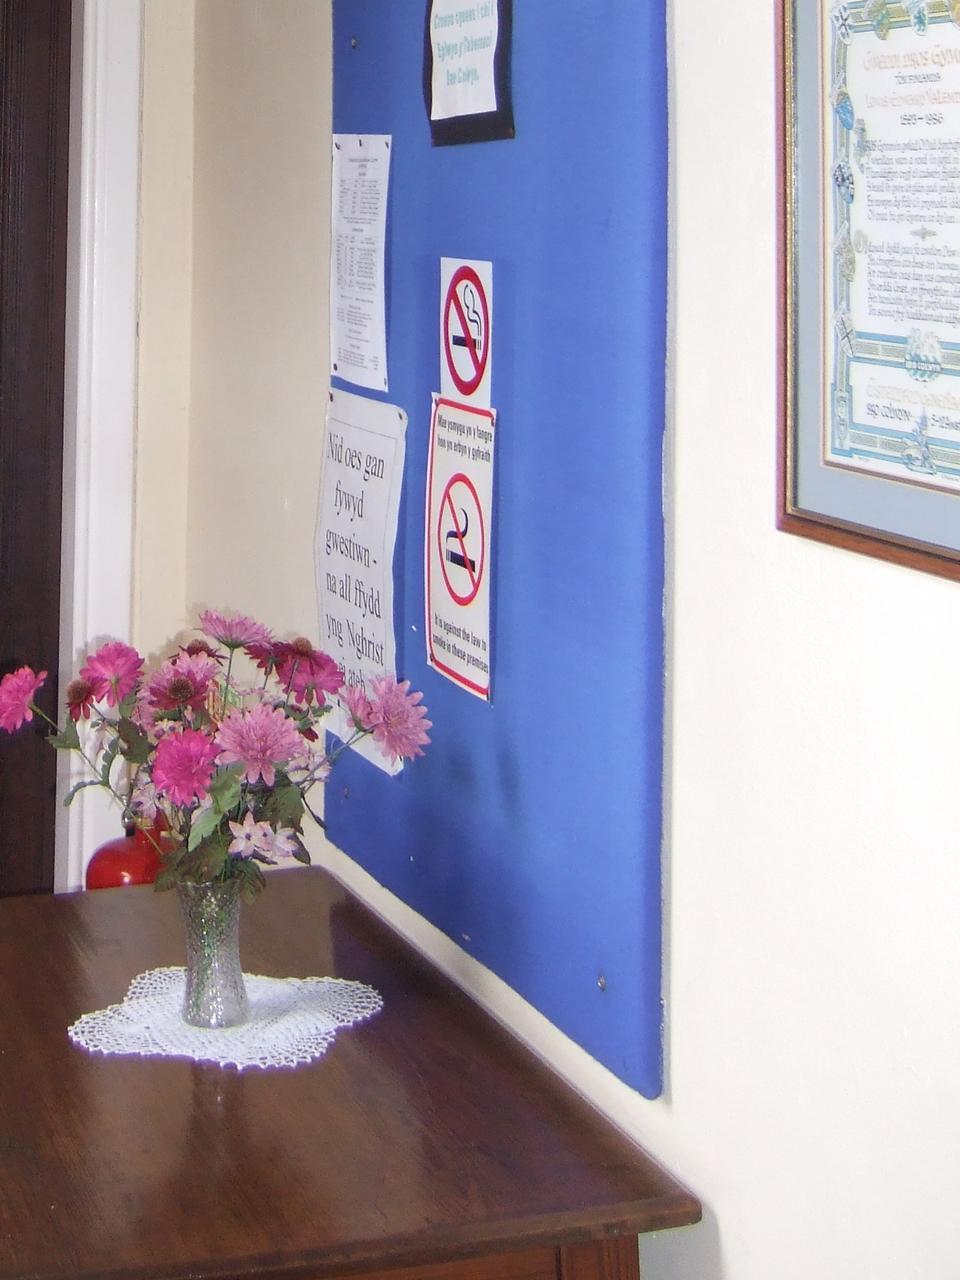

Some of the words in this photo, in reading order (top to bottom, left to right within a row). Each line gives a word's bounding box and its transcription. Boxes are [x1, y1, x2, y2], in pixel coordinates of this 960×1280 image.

[327, 432, 344, 463] Nid
[344, 447, 362, 471] oes
[363, 454, 385, 482] gan
[334, 479, 364, 522] fywyd
[326, 528, 370, 568] gwestiwn
[326, 572, 337, 595] na
[340, 573, 351, 603] all
[354, 578, 382, 619] ffydd
[326, 613, 344, 648] yng
[346, 618, 384, 667] Nghrist
